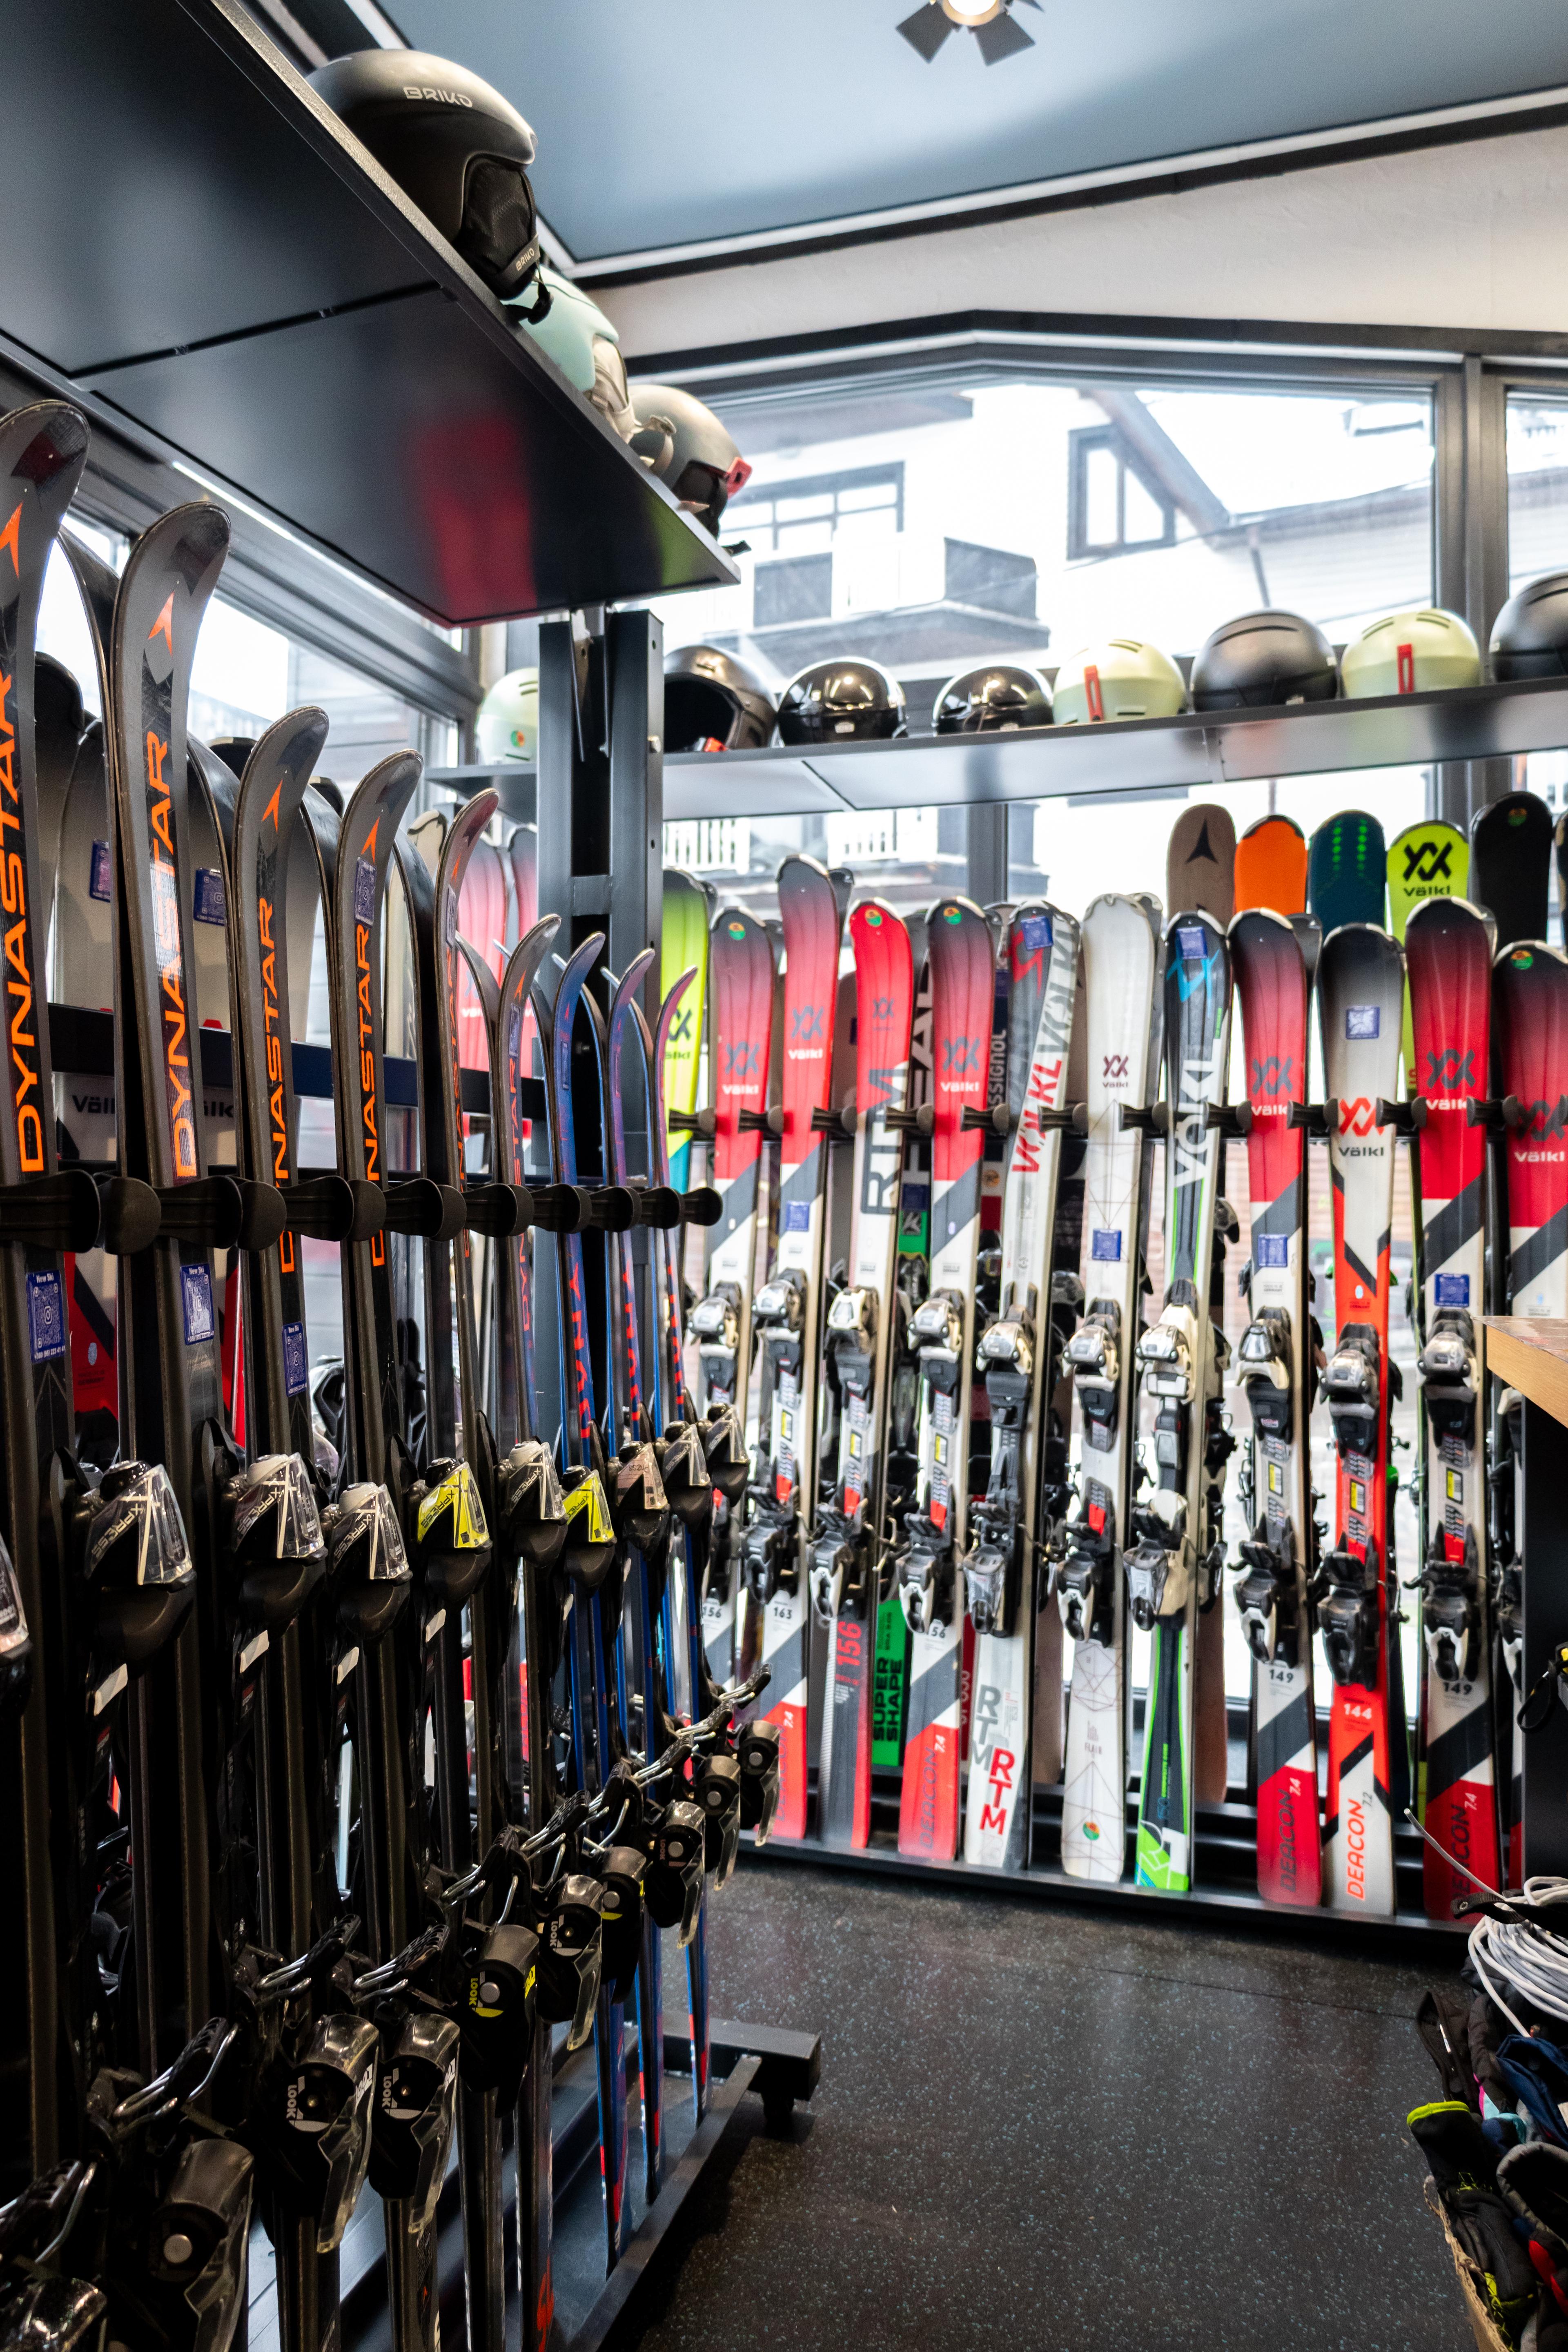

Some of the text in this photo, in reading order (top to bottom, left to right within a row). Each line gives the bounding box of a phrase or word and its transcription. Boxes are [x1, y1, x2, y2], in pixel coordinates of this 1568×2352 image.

[403, 87, 473, 108] BRIKO
[516, 247, 535, 271] BRIKO
[1403, 886, 1450, 896] Völkl
[147, 731, 197, 1176] DYNASTAR
[665, 1051, 690, 1059] ölkl
[788, 1049, 823, 1060] Völkl
[722, 1084, 759, 1095] Völkl
[940, 1081, 979, 1092] Völkl
[1252, 1104, 1287, 1116] Völk
[1426, 1098, 1467, 1110] Völk
[1339, 1147, 1384, 1157] Völkl
[1514, 1151, 1565, 1163] Völkl
[511, 1467, 541, 1503] XPRESS
[421, 1490, 455, 1529] XPRESS
[92, 1503, 145, 1558] XPRESS
[334, 1514, 372, 1559] XPRESS
[774, 1607, 793, 1619] 163
[837, 1621, 862, 1666] 156
[931, 1626, 946, 1638] 56
[1269, 1669, 1294, 1683] 149
[873, 1657, 888, 1741] SUPER
[886, 1659, 902, 1742] SHAPE
[1443, 1682, 1473, 1695] 149
[1344, 1703, 1372, 1719] 144
[920, 1746, 937, 1850] DEACON
[1278, 1788, 1296, 1892] DEACON
[1346, 1798, 1365, 1901] DEACON
[550, 1921, 558, 1947] LOOK
[469, 1978, 478, 2006] LOOK
[286, 2084, 297, 2119] LOOK
[382, 2076, 392, 2108] LOOK
